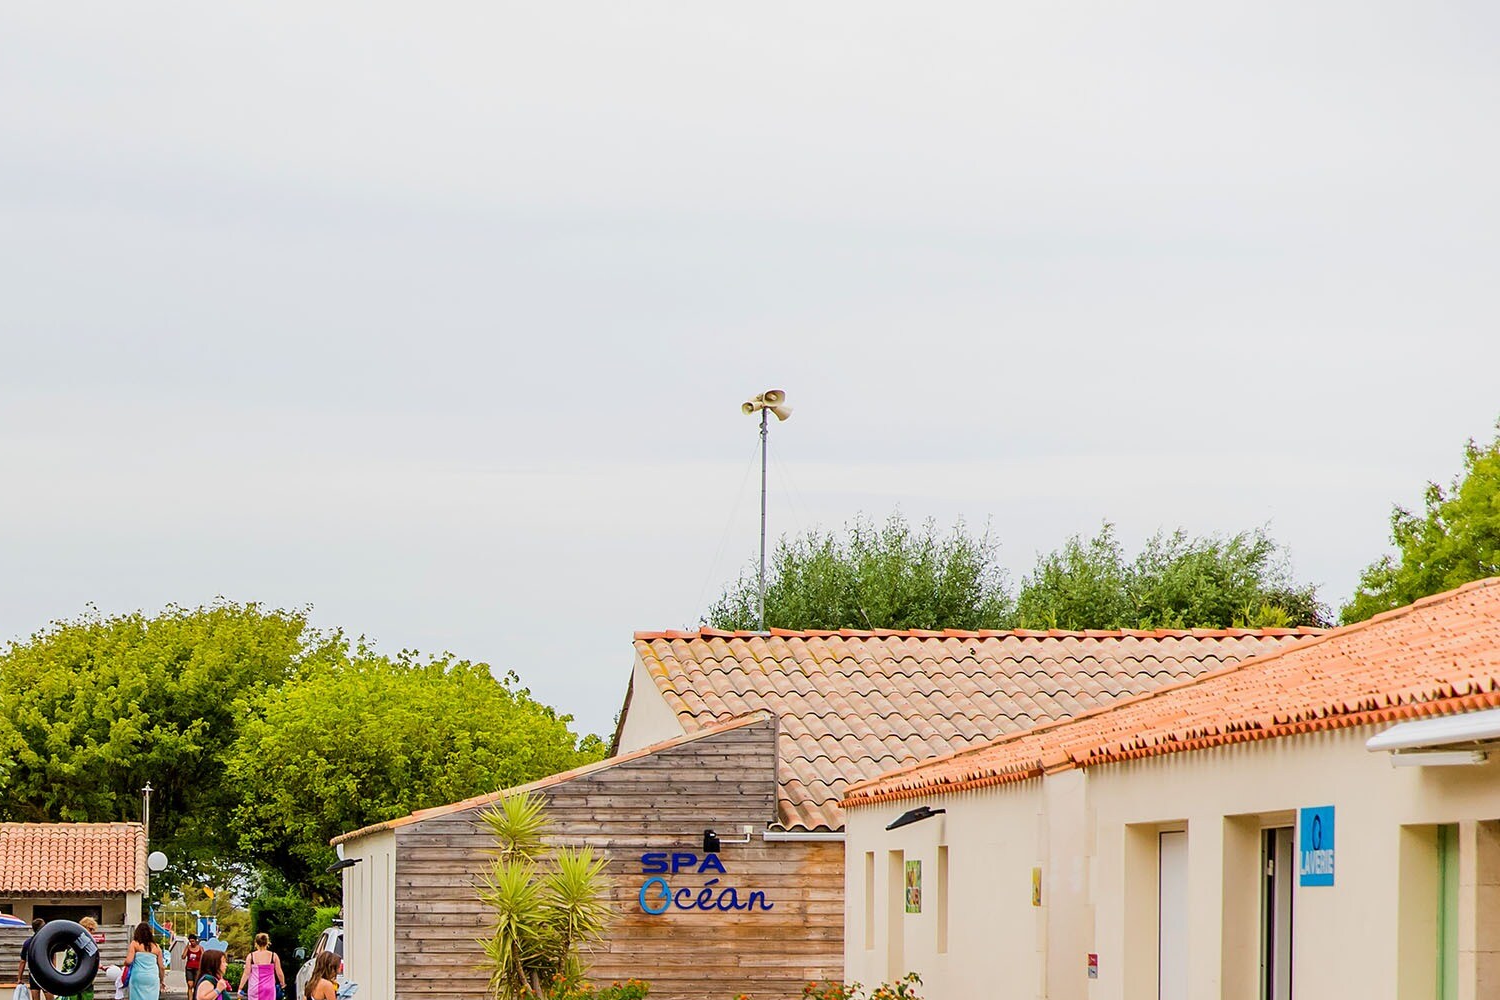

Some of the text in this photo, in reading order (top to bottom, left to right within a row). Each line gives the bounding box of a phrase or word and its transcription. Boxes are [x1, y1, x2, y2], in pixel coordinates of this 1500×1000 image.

[640, 853, 726, 873] SPA
[1300, 849, 1334, 875] LAVERIE
[639, 877, 774, 915] Océan
